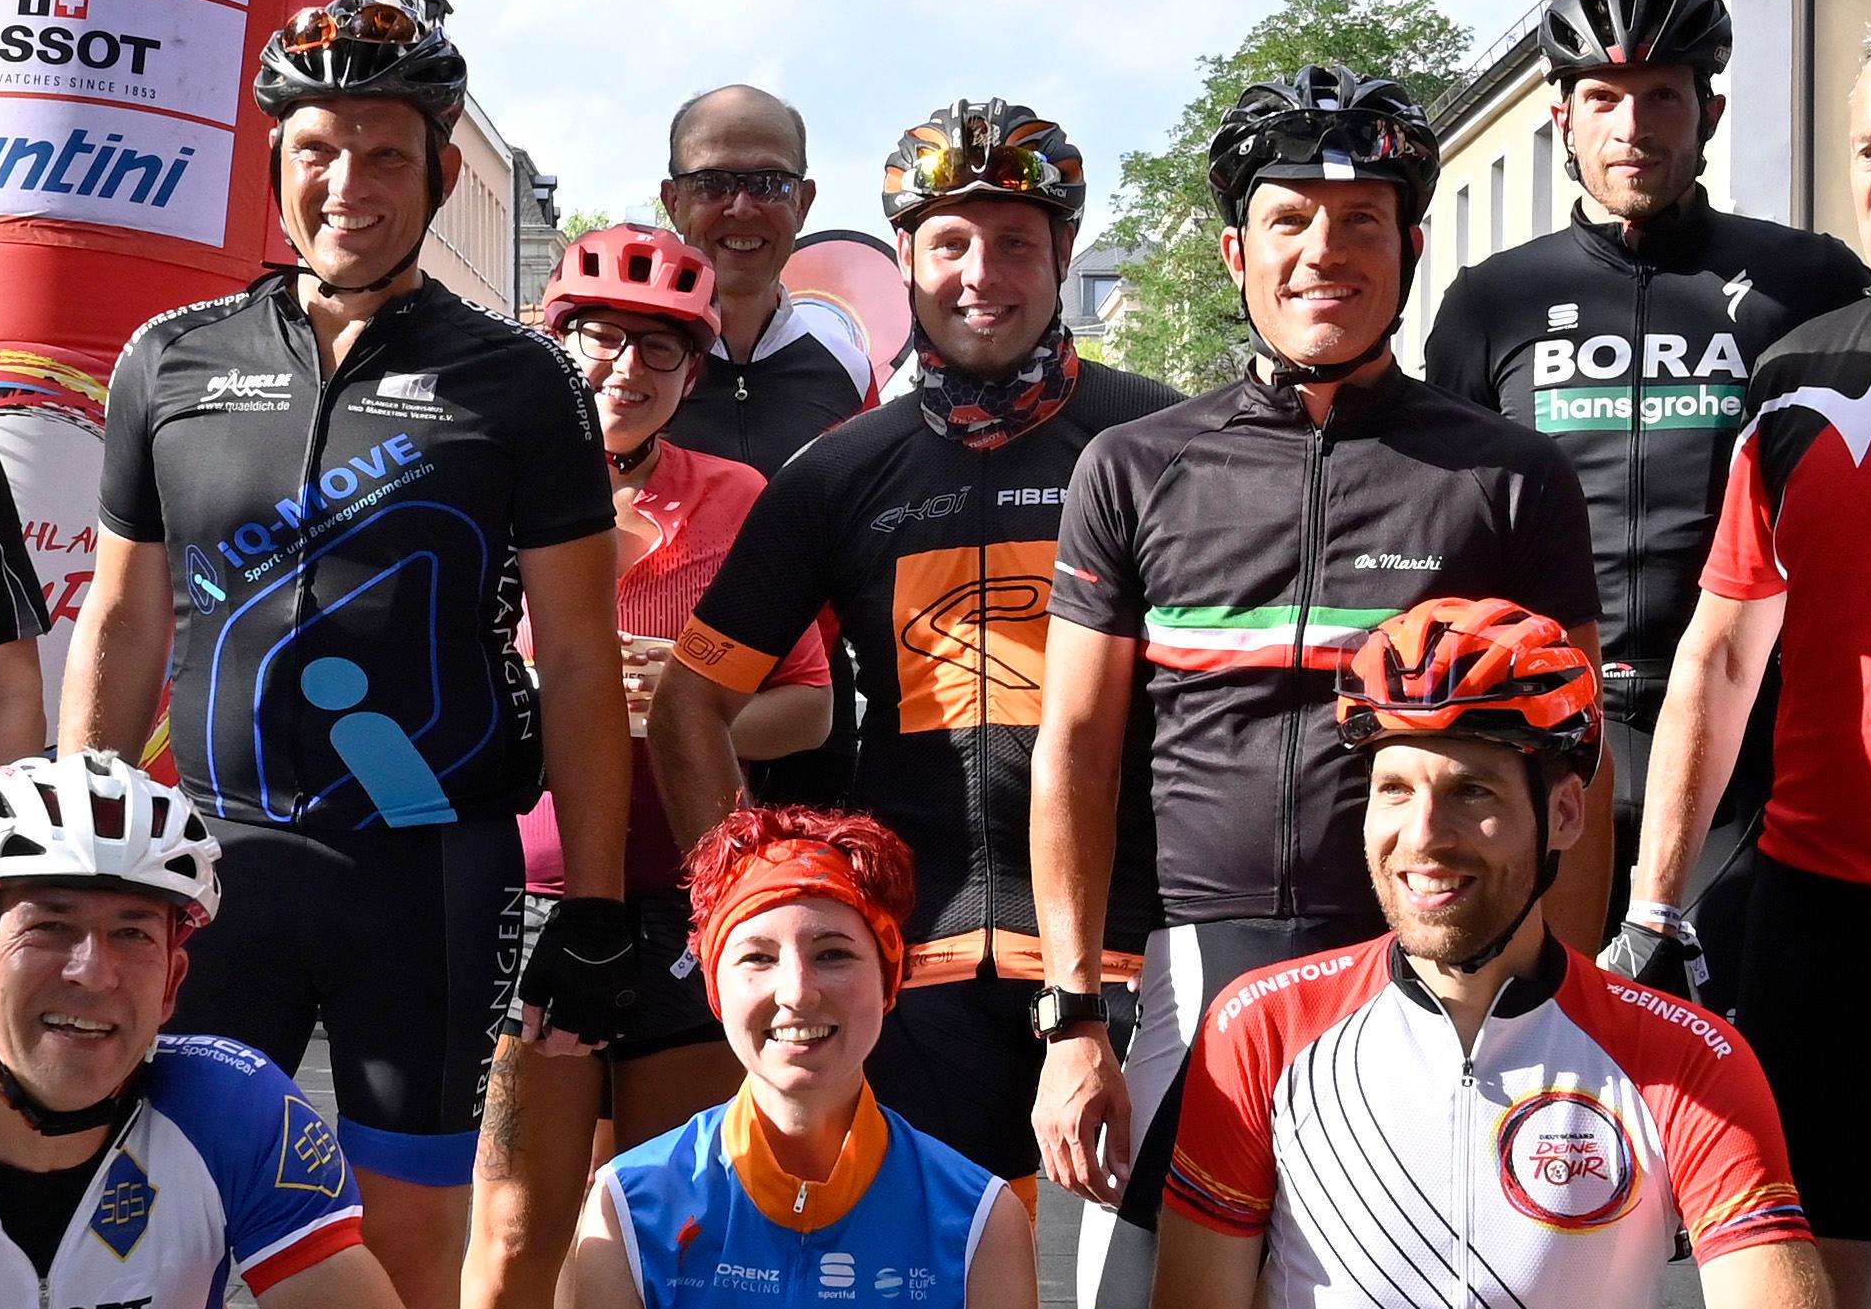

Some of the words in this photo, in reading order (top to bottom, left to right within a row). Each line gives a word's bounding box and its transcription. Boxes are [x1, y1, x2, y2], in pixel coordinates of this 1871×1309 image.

[70, 77, 115, 93] SINCE
[124, 84, 156, 98] 1853
[1533, 333, 1748, 386] BORA
[197, 401, 290, 412] www.quaeldich.de
[568, 376, 593, 441] Gruppe
[968, 433, 1000, 449] TISSOT
[309, 462, 435, 539] Bewegungsmedizin
[1355, 554, 1377, 568] De
[1379, 554, 1442, 570] Marchi
[1217, 955, 1355, 1032] #DEINETOUR
[1606, 982, 1733, 1059] #DEINETOUR
[180, 1045, 257, 1077] Sportswear
[1536, 1141, 1598, 1155] DEINE
[1529, 1156, 1608, 1186] TOUR
[717, 1263, 780, 1281] ORENZ
[818, 1290, 855, 1299] sportful
